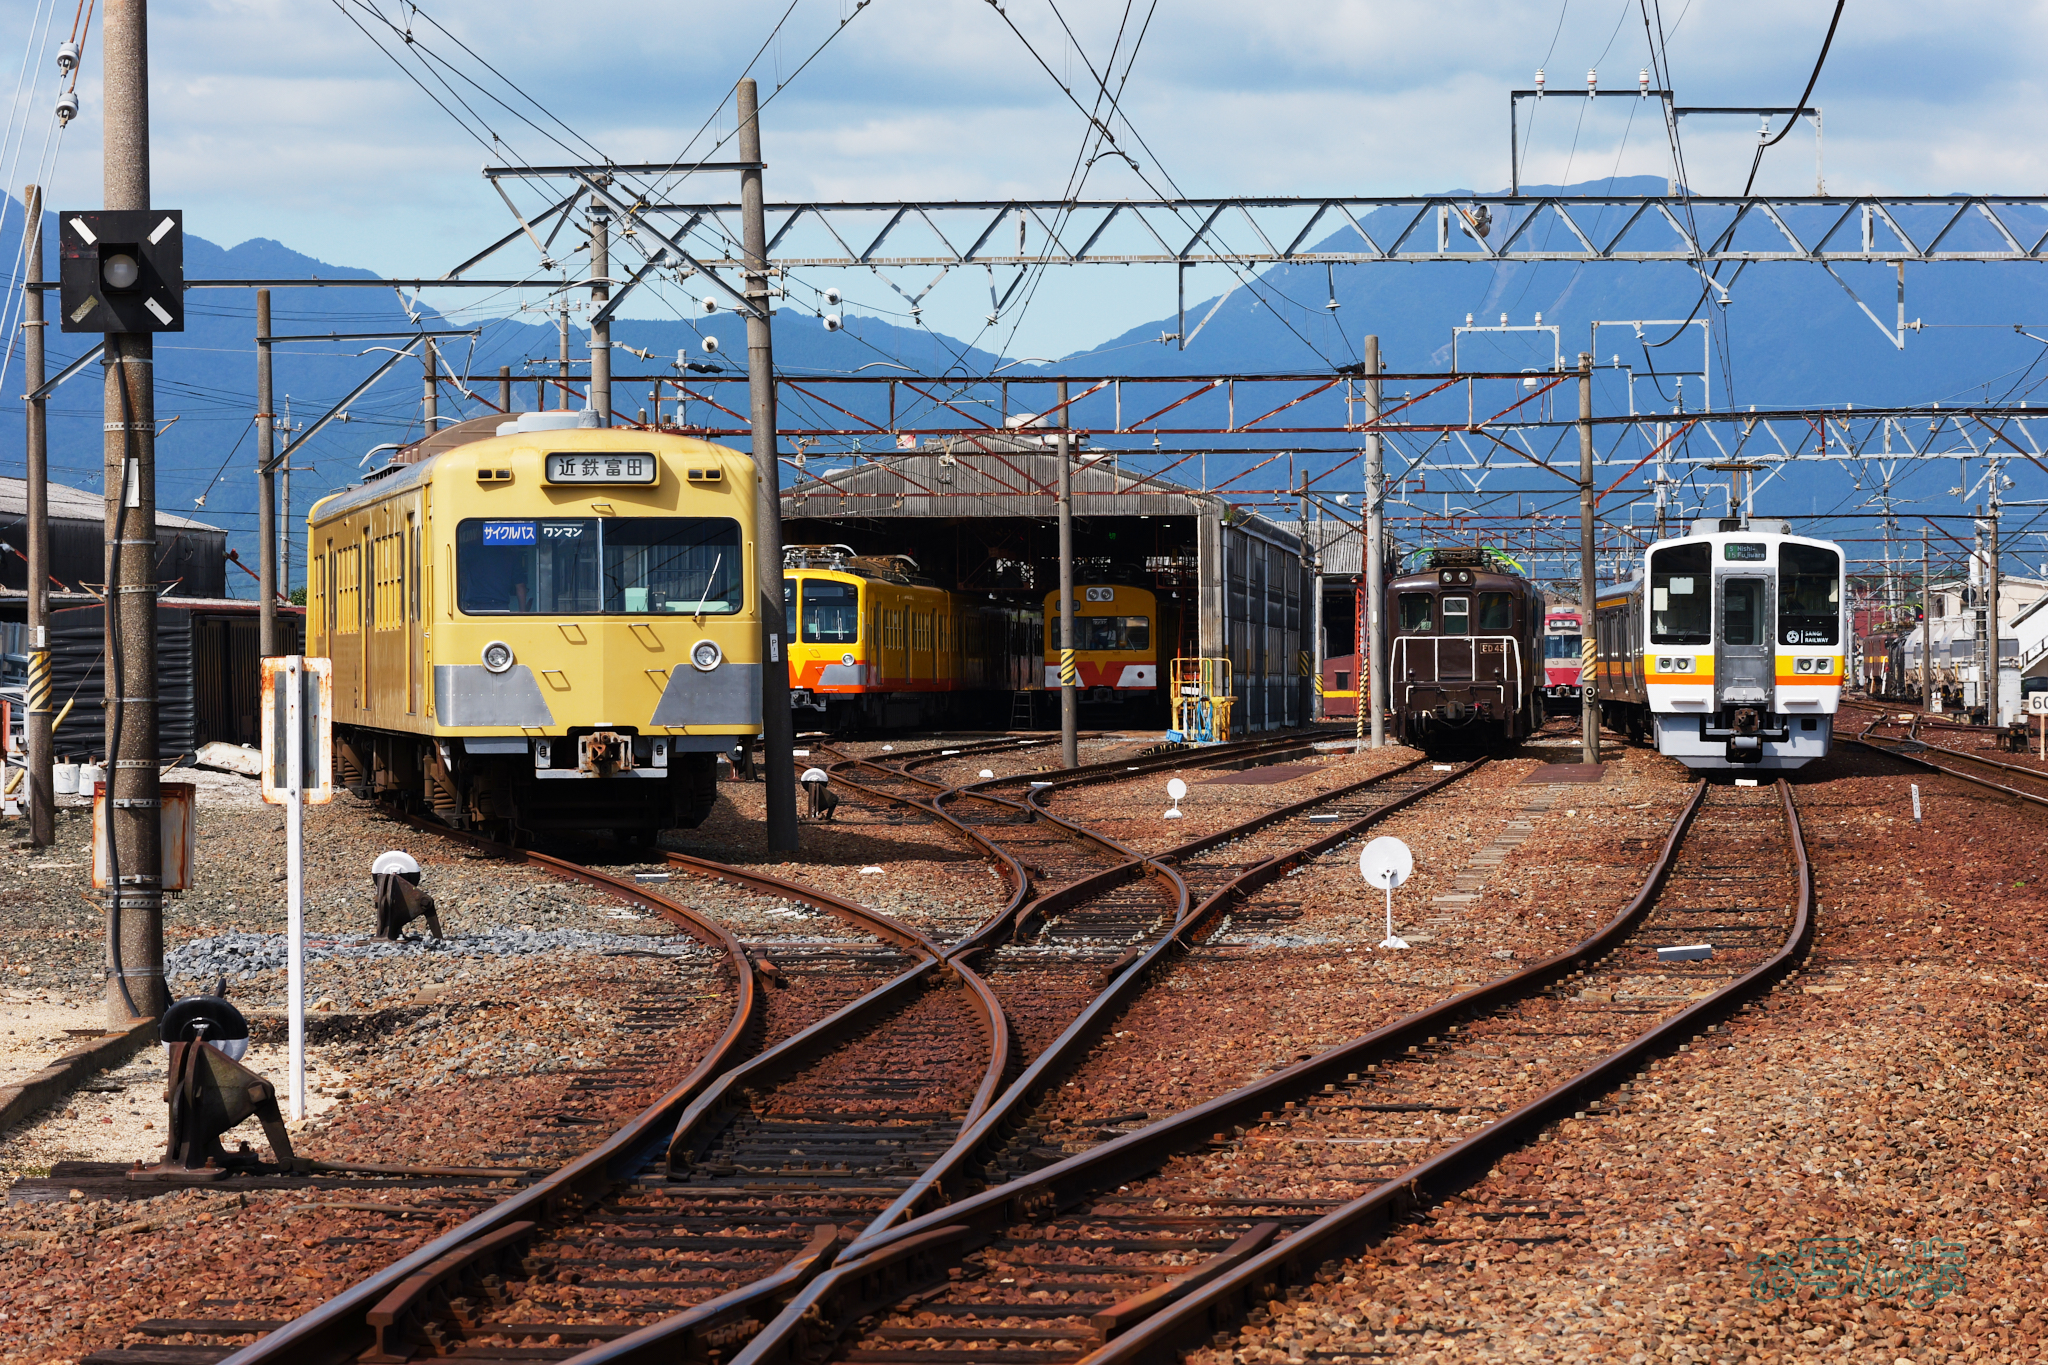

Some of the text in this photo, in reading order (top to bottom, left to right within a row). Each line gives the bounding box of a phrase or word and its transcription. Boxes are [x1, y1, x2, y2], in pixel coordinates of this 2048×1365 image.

[558, 457, 643, 477] 近鉄富田
[543, 527, 583, 538] ワンマン
